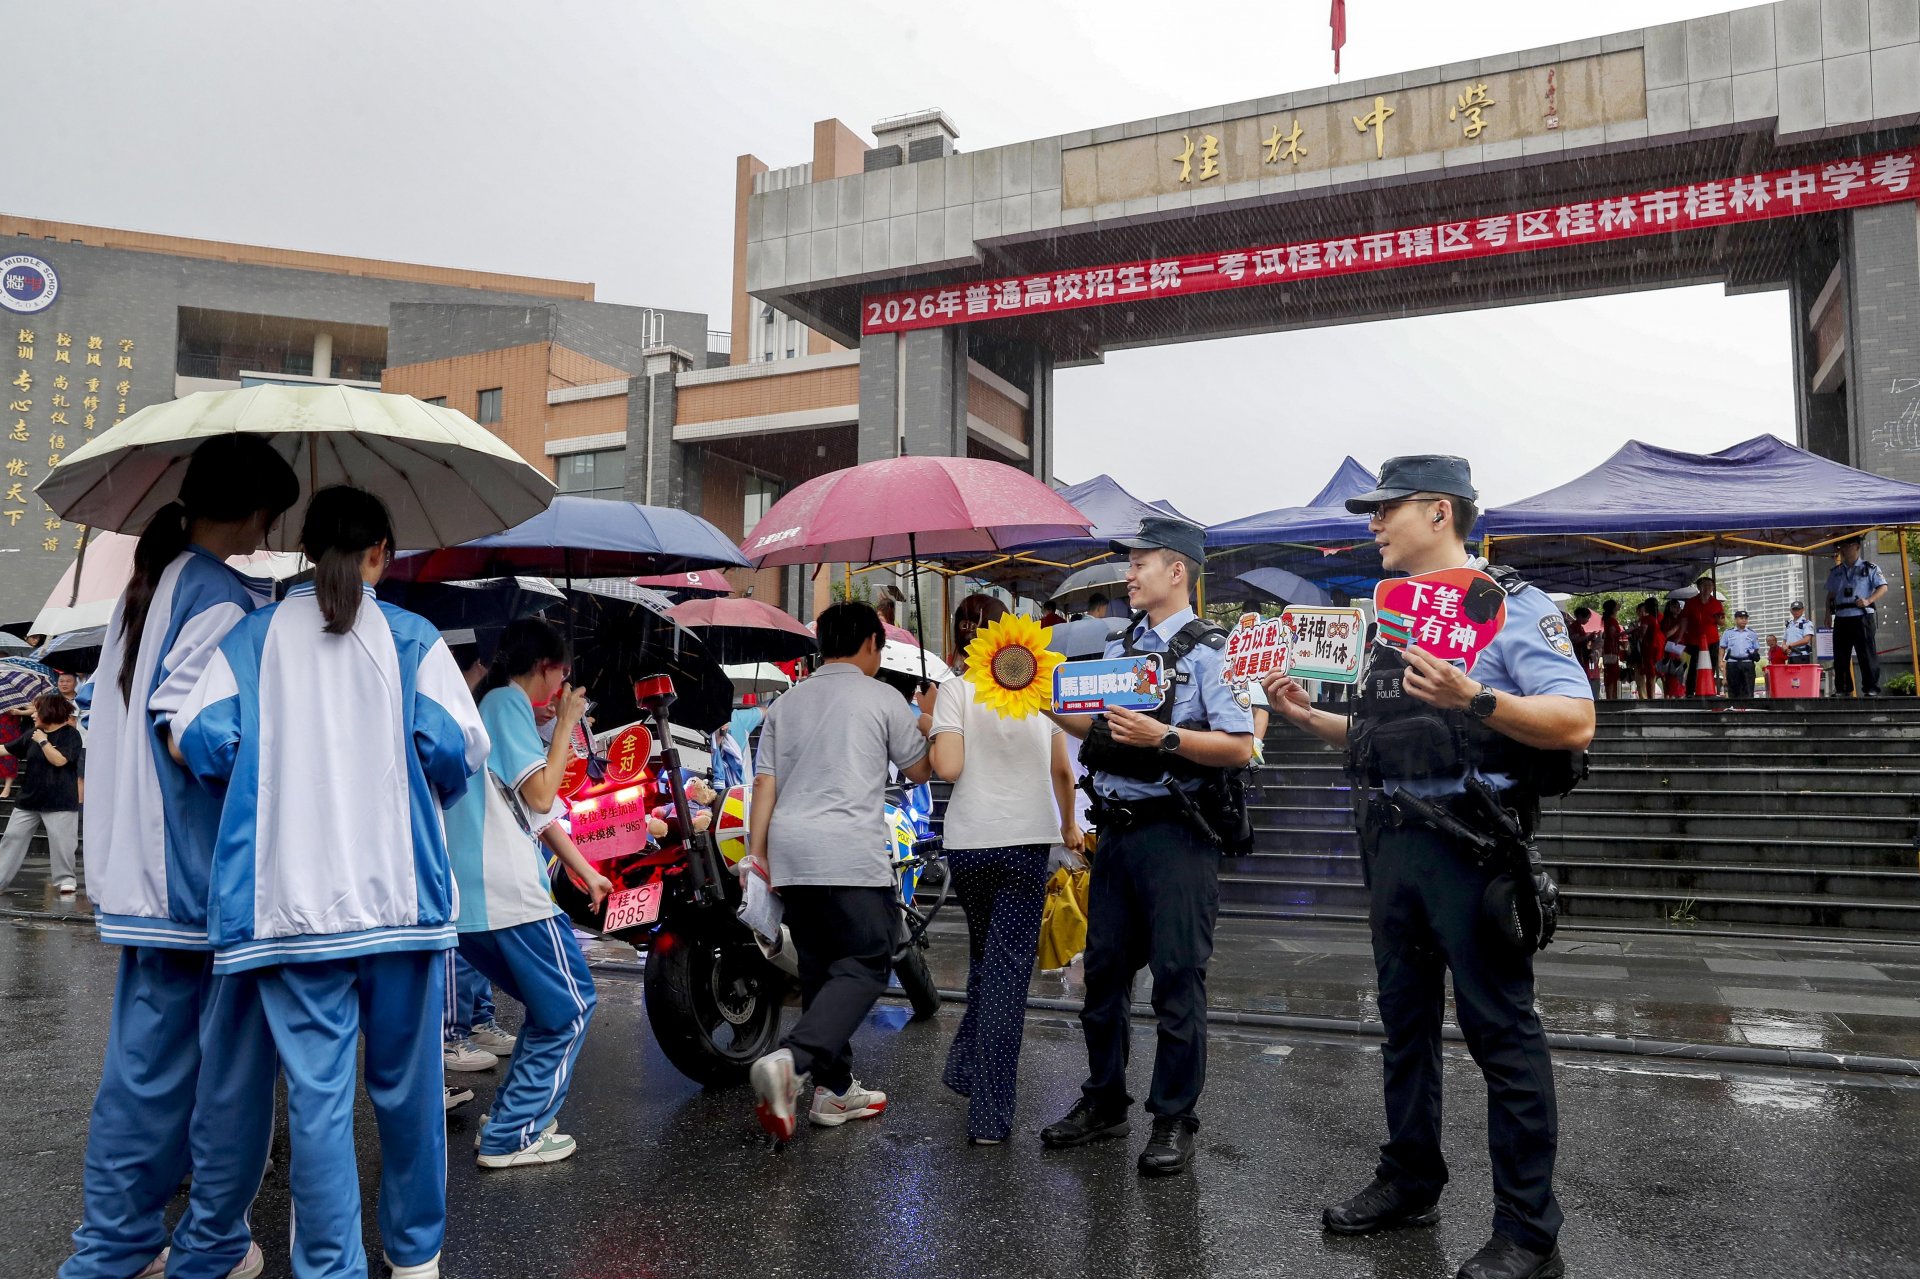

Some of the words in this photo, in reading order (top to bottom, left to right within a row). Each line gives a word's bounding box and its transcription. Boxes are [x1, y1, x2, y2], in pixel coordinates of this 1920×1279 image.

[1173, 83, 1495, 183] 桂林中学
[4, 257, 42, 268] MIDDLE
[43, 267, 56, 299] SCHOOL
[17, 328, 34, 361] 校训
[54, 332, 72, 364] 校风
[86, 336, 103, 367] 教风
[117, 339, 134, 370] 学风
[1407, 581, 1461, 618] 下笔
[1228, 625, 1277, 655] 全力以赴
[1297, 615, 1327, 642] 考神
[1420, 615, 1477, 652] 有神
[1235, 647, 1286, 676] 便是最好
[1315, 640, 1348, 664] 附体
[1376, 690, 1400, 699] POLICE
[619, 734, 638, 774] 全对
[579, 801, 638, 825] 各位考生加油
[606, 904, 646, 930] 0985
